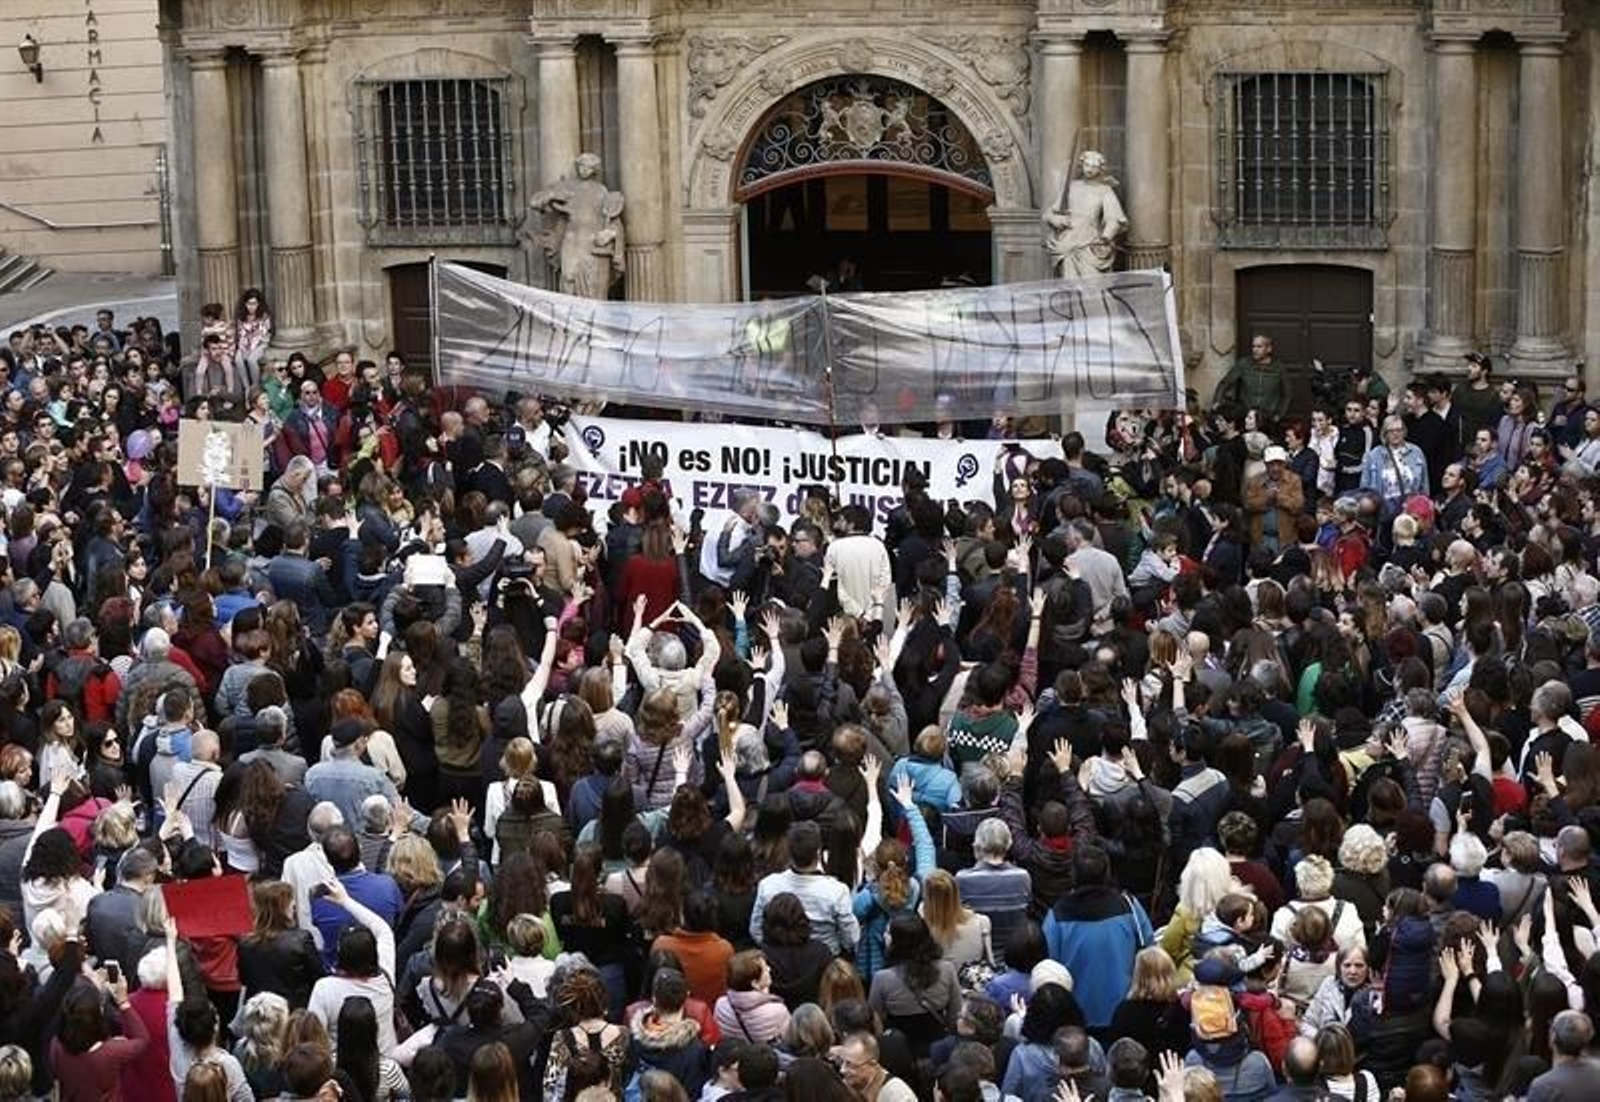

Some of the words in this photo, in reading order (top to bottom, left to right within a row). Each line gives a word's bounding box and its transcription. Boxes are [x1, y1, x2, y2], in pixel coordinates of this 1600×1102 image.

[85, 0, 104, 143] ARMACIA
[619, 440, 669, 472] ¡NO
[679, 449, 711, 472] es
[721, 446, 771, 476] NO!
